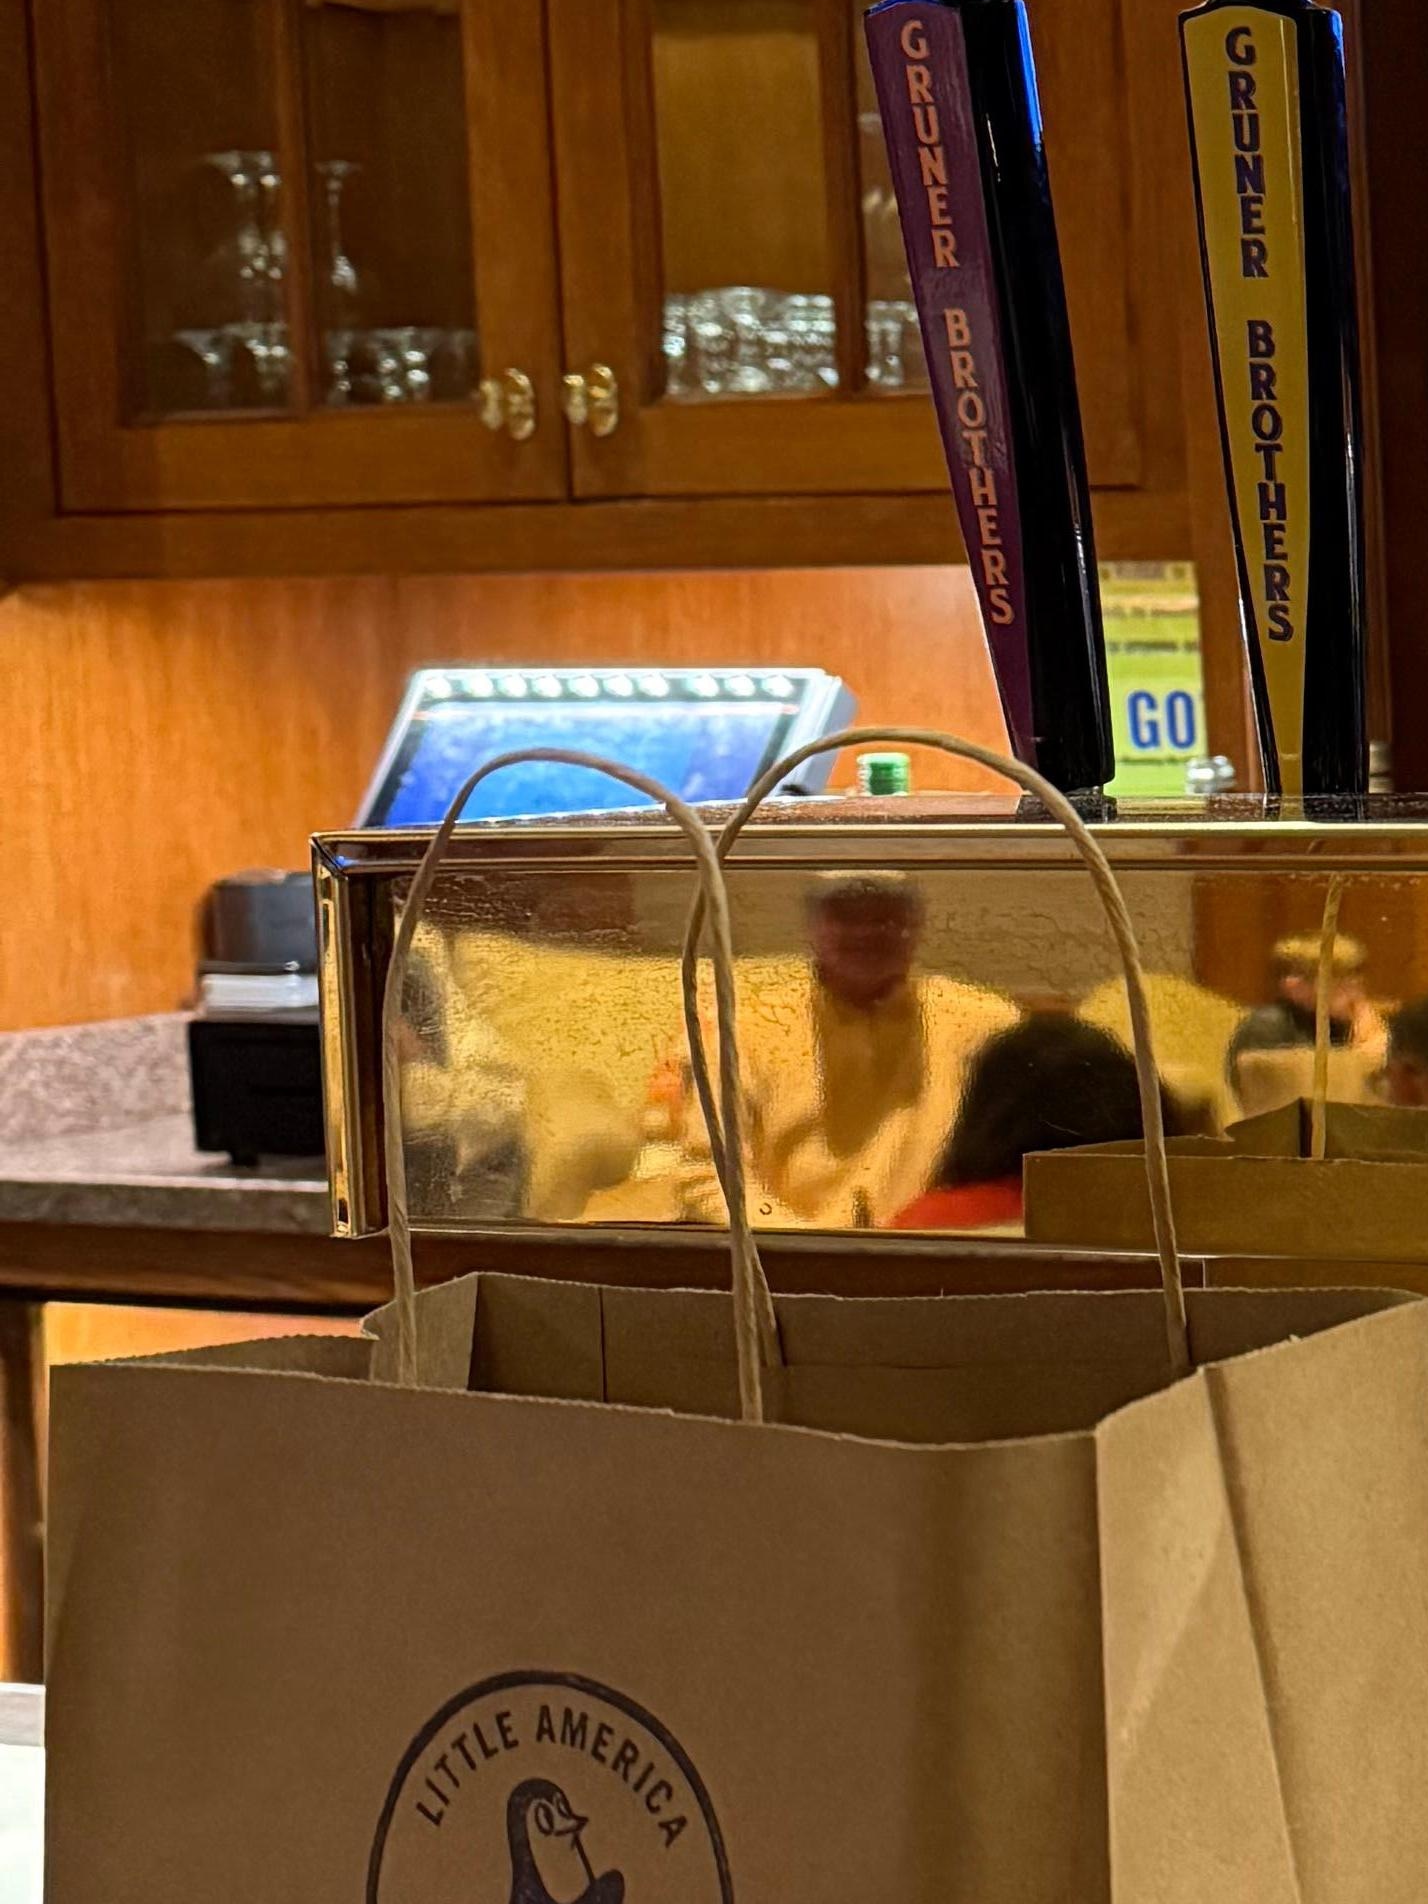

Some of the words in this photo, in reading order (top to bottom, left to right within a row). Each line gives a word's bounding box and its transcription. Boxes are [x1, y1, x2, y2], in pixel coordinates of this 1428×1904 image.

[1225, 25, 1269, 279] GRUNER
[901, 19, 959, 268] GRUNER
[944, 308, 1016, 625] BROTHERS
[1246, 318, 1295, 643] BROTHERS
[1127, 690, 1197, 750] GO
[416, 1710, 520, 1827] LITTLE
[536, 1704, 690, 1849] AMERICA
